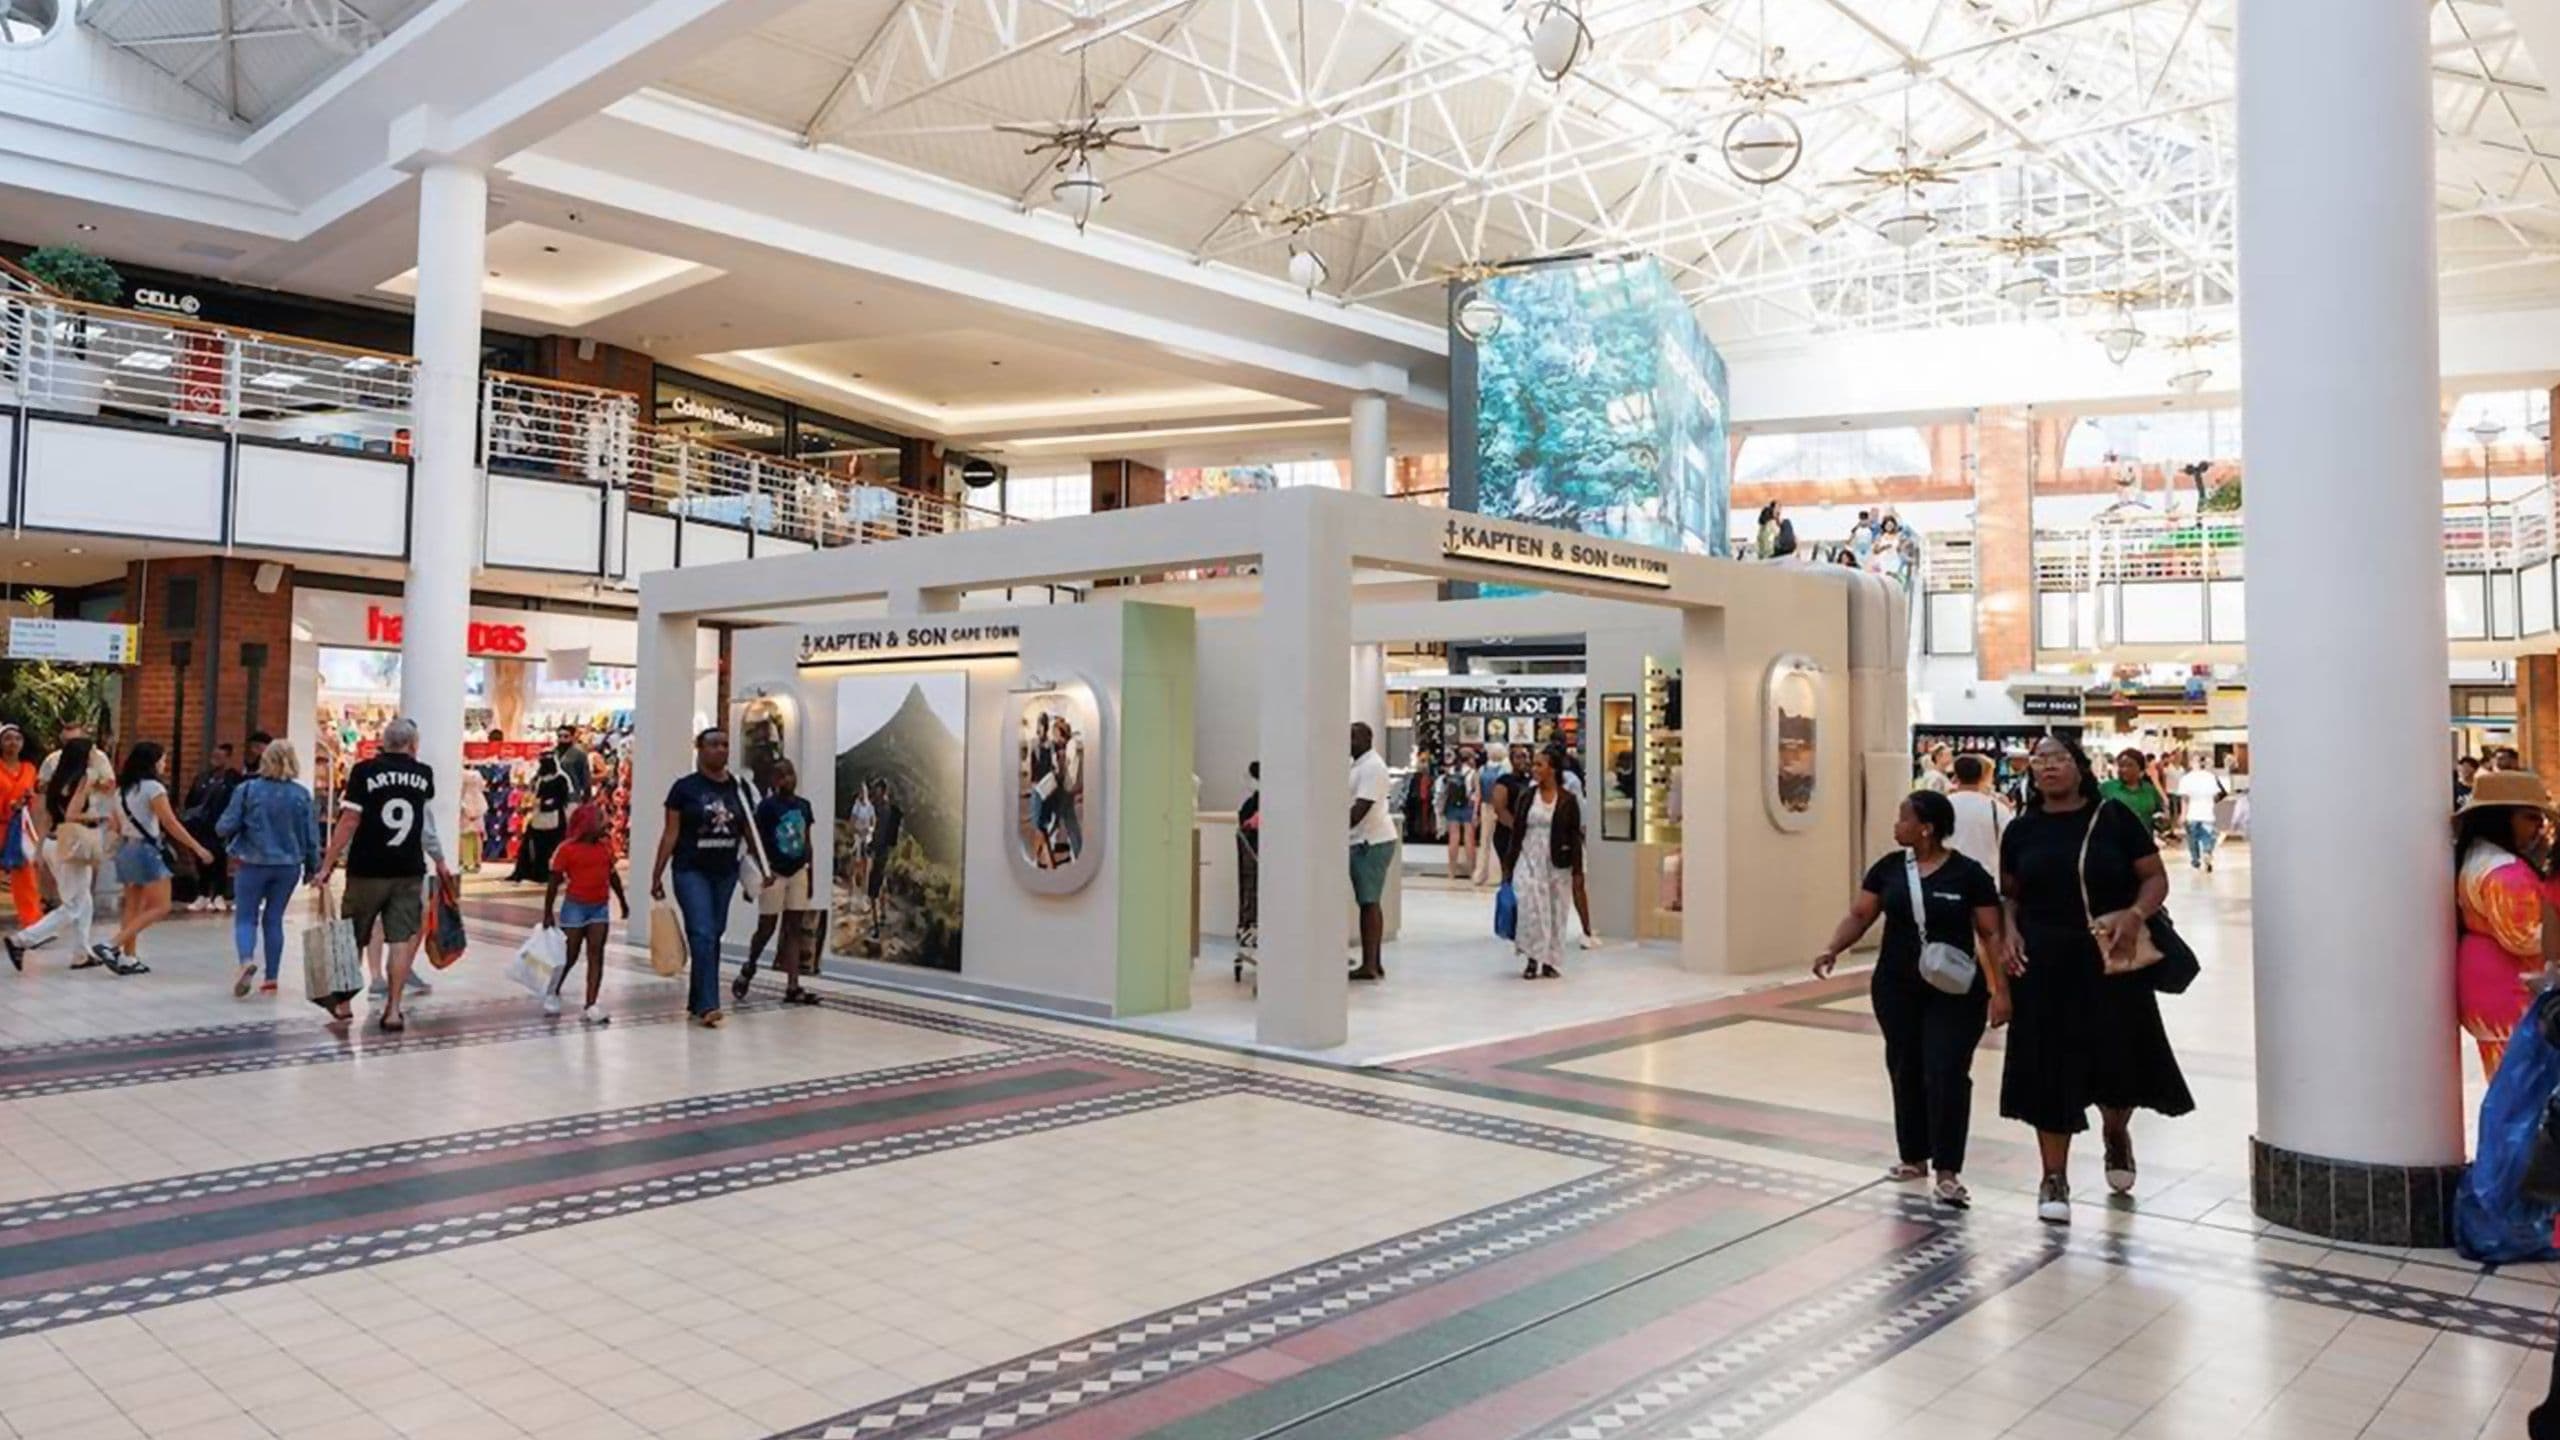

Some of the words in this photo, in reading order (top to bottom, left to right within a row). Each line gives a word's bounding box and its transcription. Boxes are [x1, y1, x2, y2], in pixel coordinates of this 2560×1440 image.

[673, 397, 712, 420] Calvin
[712, 405, 741, 428] Klein
[741, 415, 774, 437] Jeans
[1462, 526, 1543, 558] KAPTEN
[1551, 541, 1564, 560] &
[1571, 545, 1608, 568] SON
[1612, 554, 1637, 570] CAPE
[1641, 560, 1668, 574] TOWN
[814, 632, 881, 651] KAPTEN
[886, 631, 899, 648] &
[907, 627, 947, 647] SON
[951, 627, 980, 642] CAPE
[985, 625, 1020, 641] TOWN
[1463, 697, 1512, 713] AFRIKA
[1515, 696, 1548, 714] JOE
[366, 771, 429, 793] ARTHUR
[382, 798, 415, 847] 9
